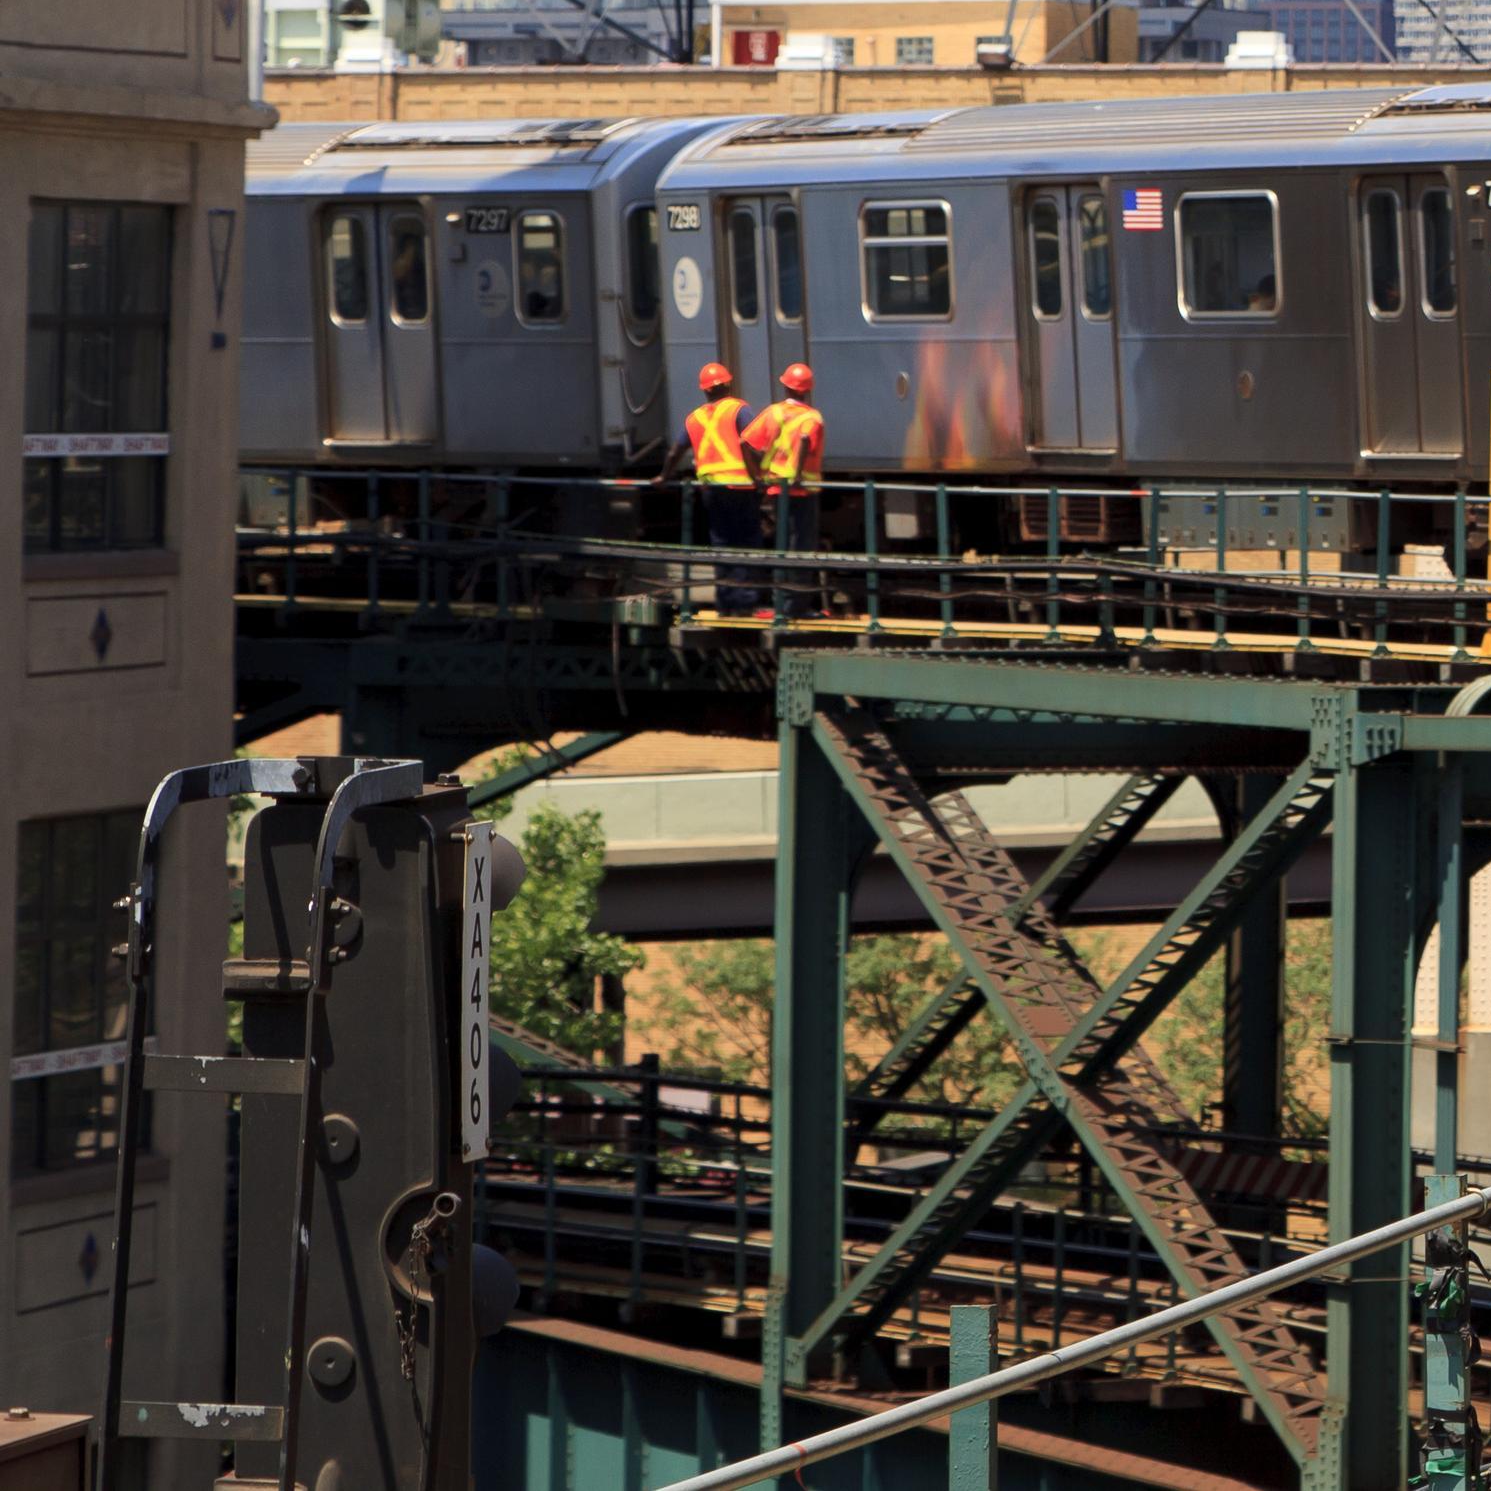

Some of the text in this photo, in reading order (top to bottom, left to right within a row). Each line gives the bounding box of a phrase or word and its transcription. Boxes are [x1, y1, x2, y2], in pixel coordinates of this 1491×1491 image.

[466, 209, 508, 231] 7297
[667, 205, 701, 230] 7298
[469, 856, 485, 1126] XA406
